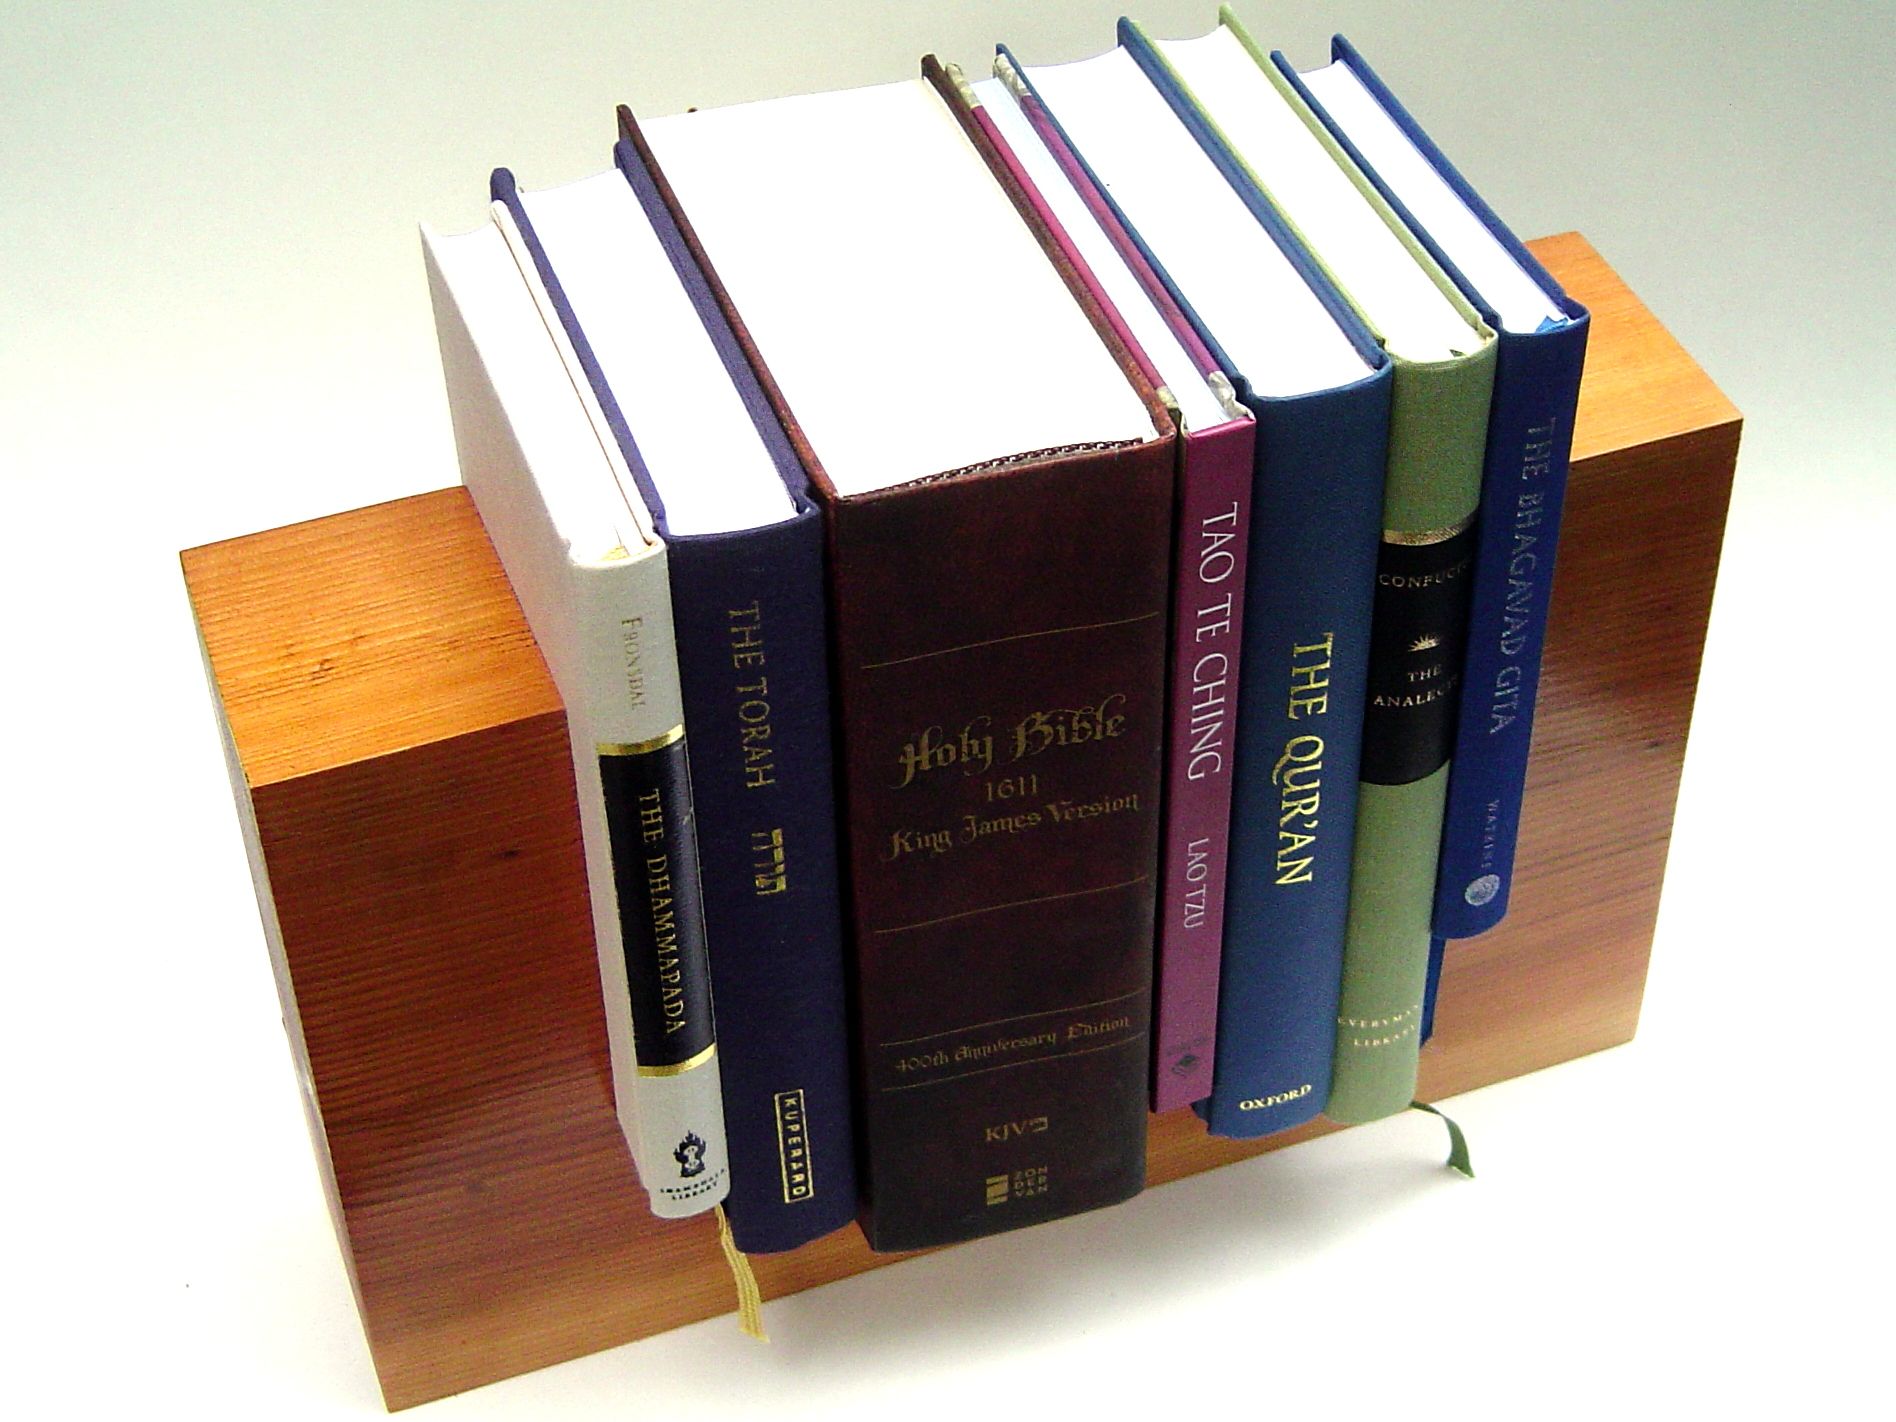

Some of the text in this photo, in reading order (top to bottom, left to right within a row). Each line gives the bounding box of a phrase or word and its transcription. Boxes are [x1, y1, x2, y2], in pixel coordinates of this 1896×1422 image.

[1488, 417, 1556, 734] THE BHAGAVAD GITA
[1187, 501, 1238, 781] TAO TE CHING
[1286, 631, 1335, 721] THE
[1407, 663, 1443, 683] THE
[729, 600, 777, 788] THE TORAH
[888, 693, 1127, 790] Holy Bible
[879, 793, 1141, 863] King James Version
[986, 774, 1038, 801] 1611
[639, 788, 686, 1034] THE DHAMMAPADA
[1184, 837, 1210, 930] LAO TZU
[896, 1016, 1132, 1074] 400th Anniversary Edition
[985, 1120, 1028, 1142] KJV
[1239, 1084, 1312, 1112] OXFORD
[784, 1097, 807, 1196] KUPERARD
